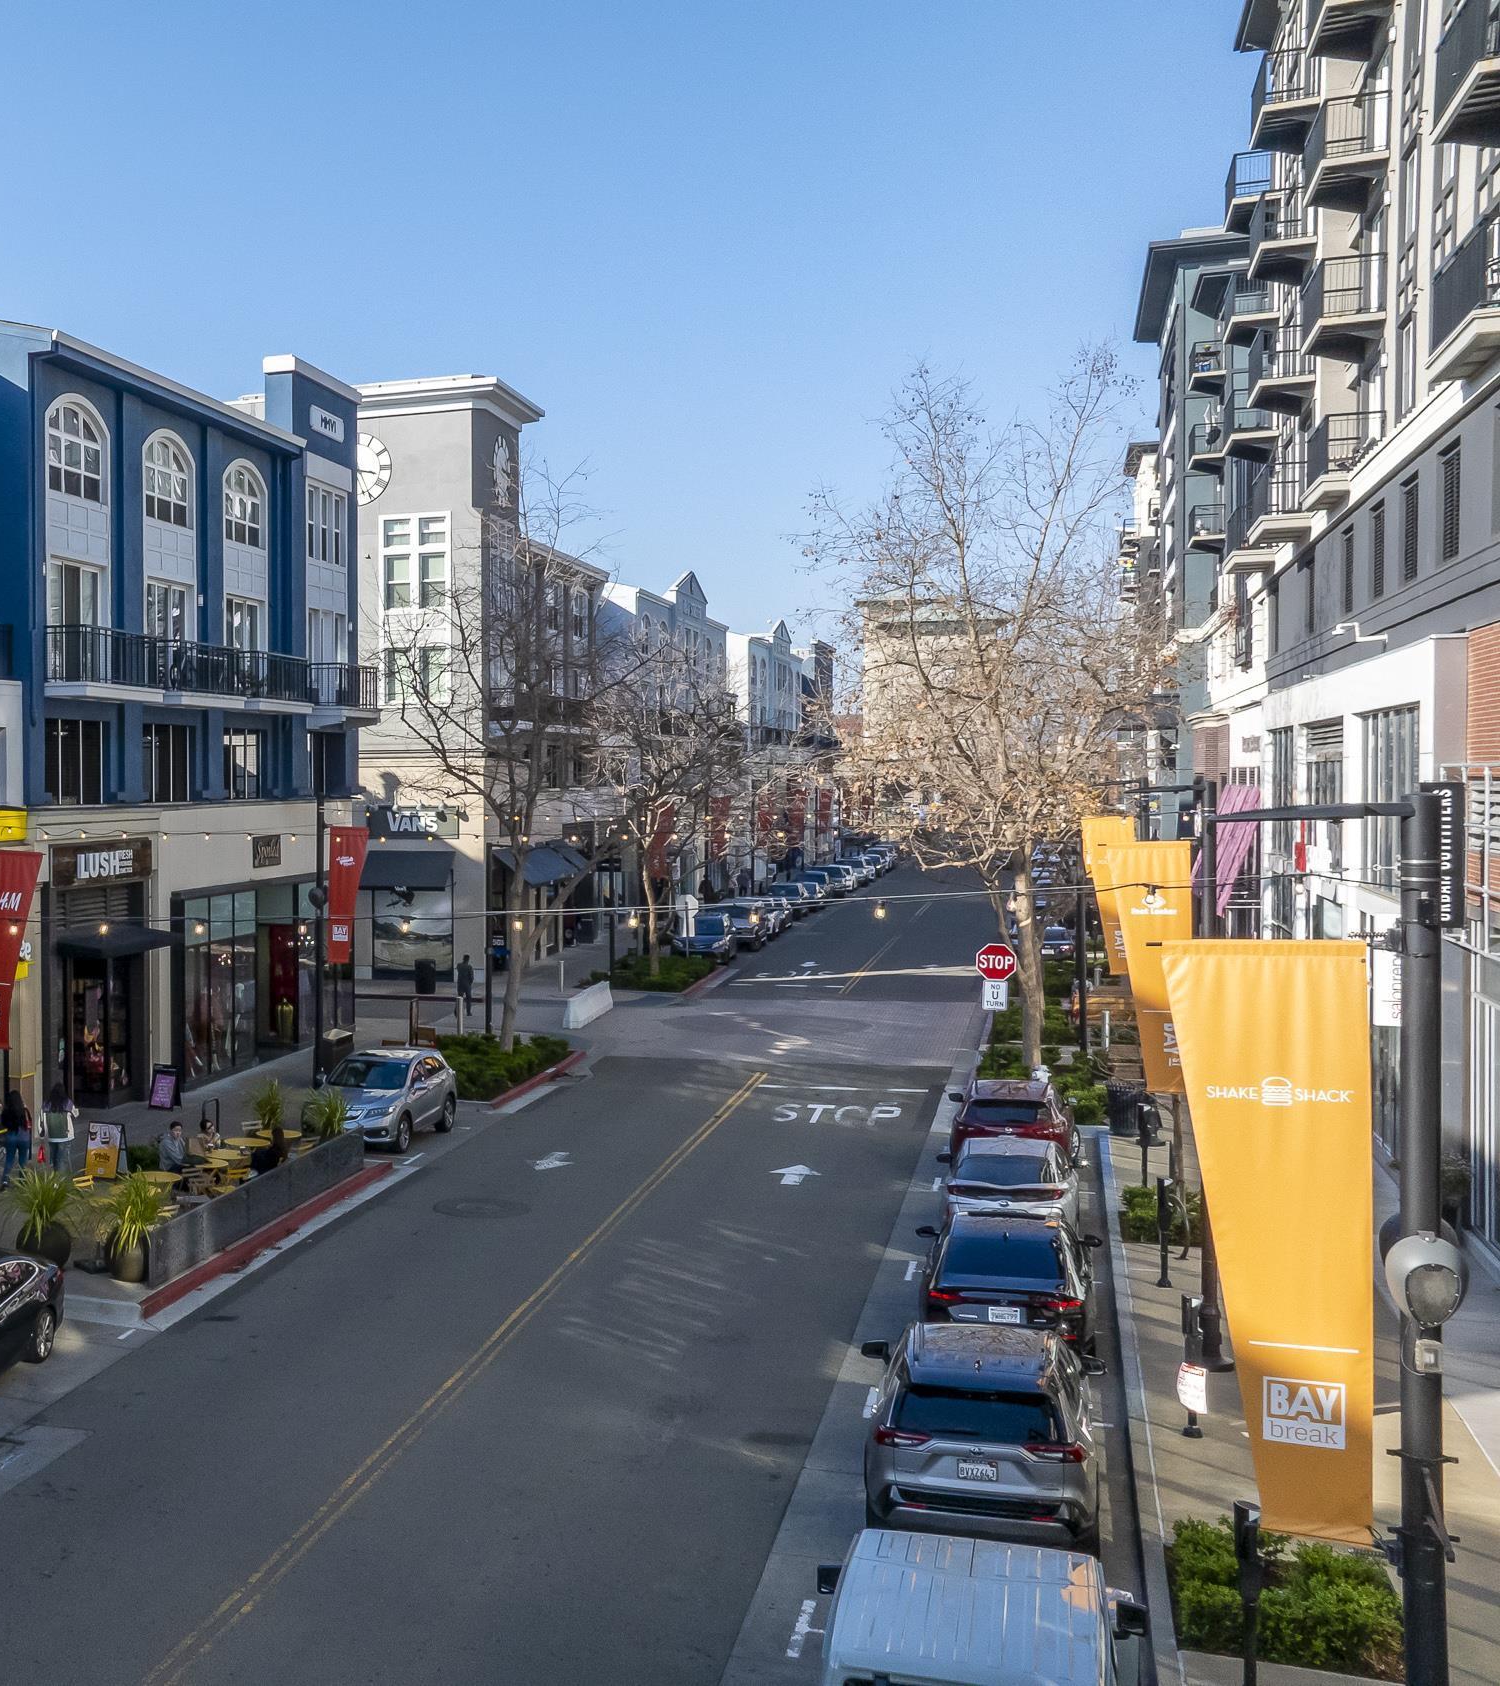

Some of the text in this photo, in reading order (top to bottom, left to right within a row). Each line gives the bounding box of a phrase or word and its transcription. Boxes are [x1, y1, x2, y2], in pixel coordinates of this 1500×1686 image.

[386, 810, 438, 833] VANS
[77, 852, 120, 879] LUSH
[978, 954, 1014, 970] STOP
[985, 1000, 1005, 1008] TURN
[991, 990, 999, 1000] U
[1206, 1085, 1352, 1103] SHAKE SHACK
[772, 1102, 902, 1126] STOP
[1270, 1383, 1339, 1422] BAY
[1268, 1419, 1338, 1445] break
